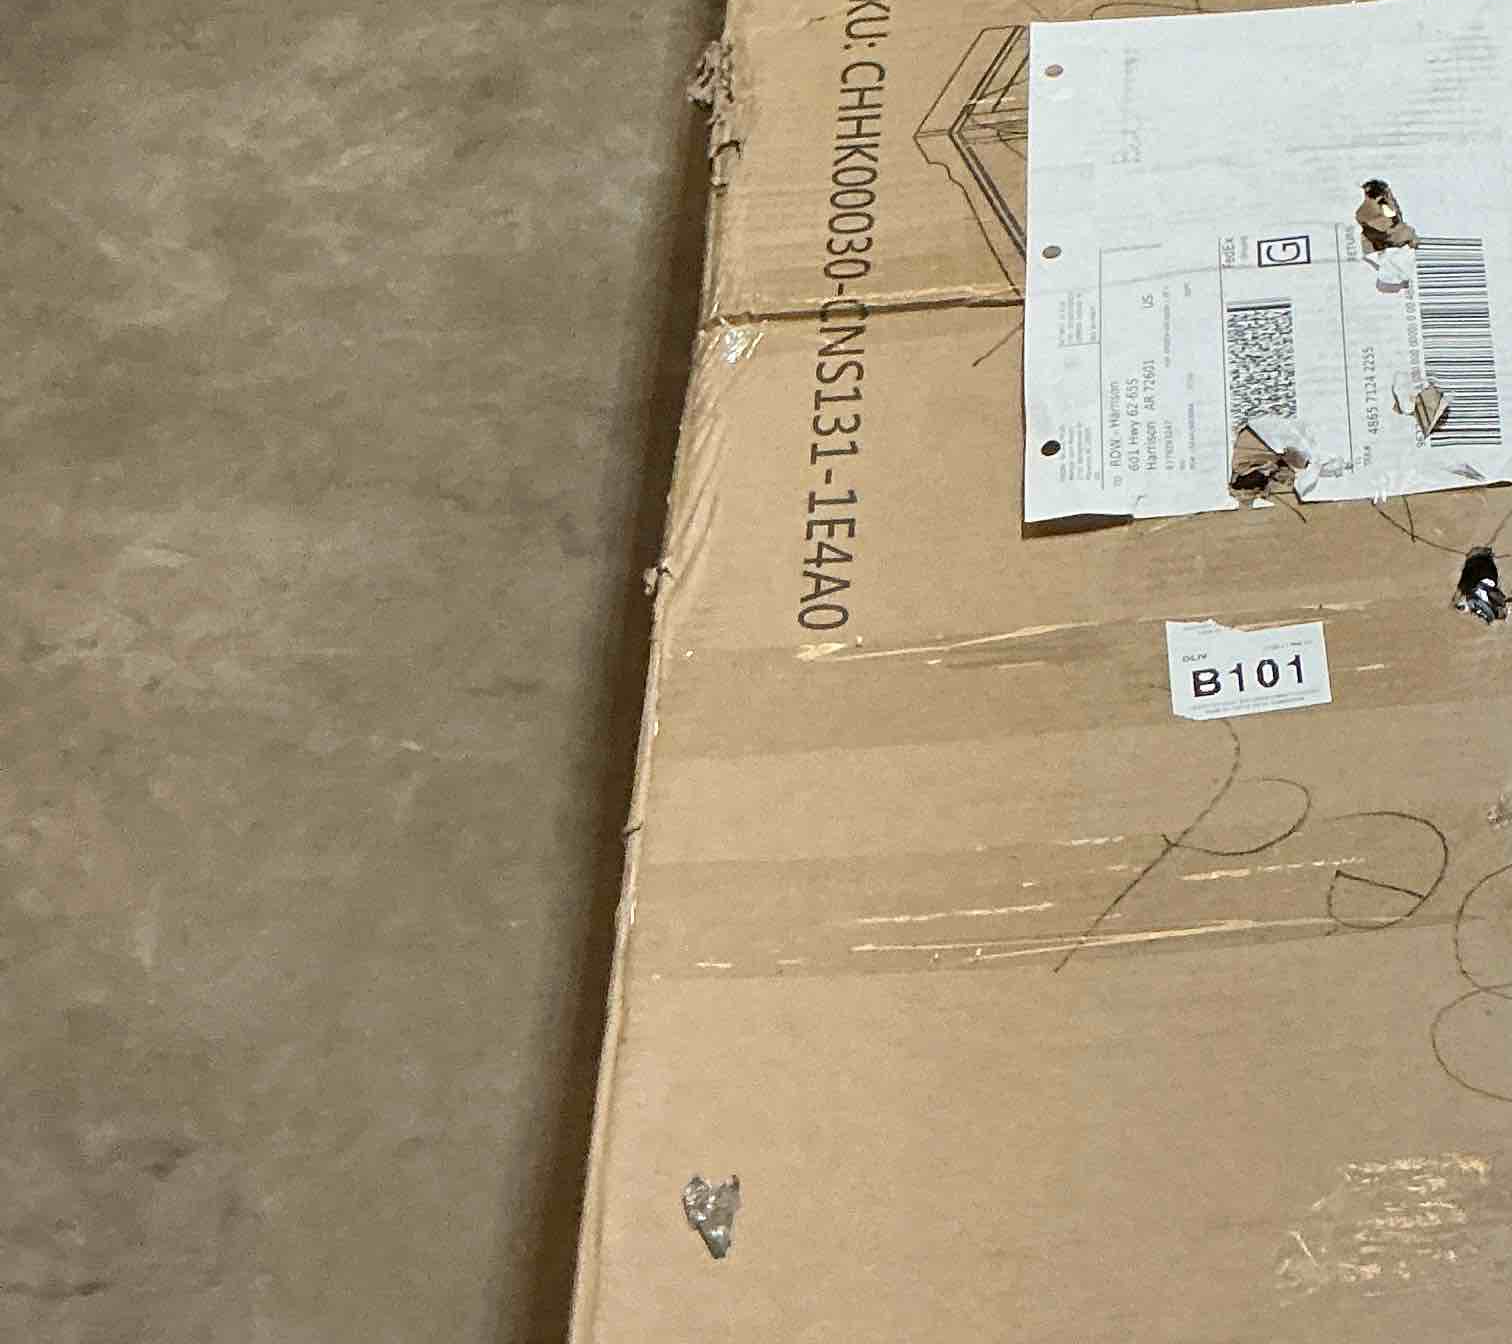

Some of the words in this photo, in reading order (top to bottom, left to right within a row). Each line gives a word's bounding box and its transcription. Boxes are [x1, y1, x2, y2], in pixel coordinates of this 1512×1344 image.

[1266, 240, 1301, 263] G
[1142, 294, 1154, 309] US
[1144, 396, 1156, 411] AR
[1127, 420, 1141, 445] Hwy
[1144, 422, 1158, 471] Harrison
[1191, 654, 1304, 698] B101
